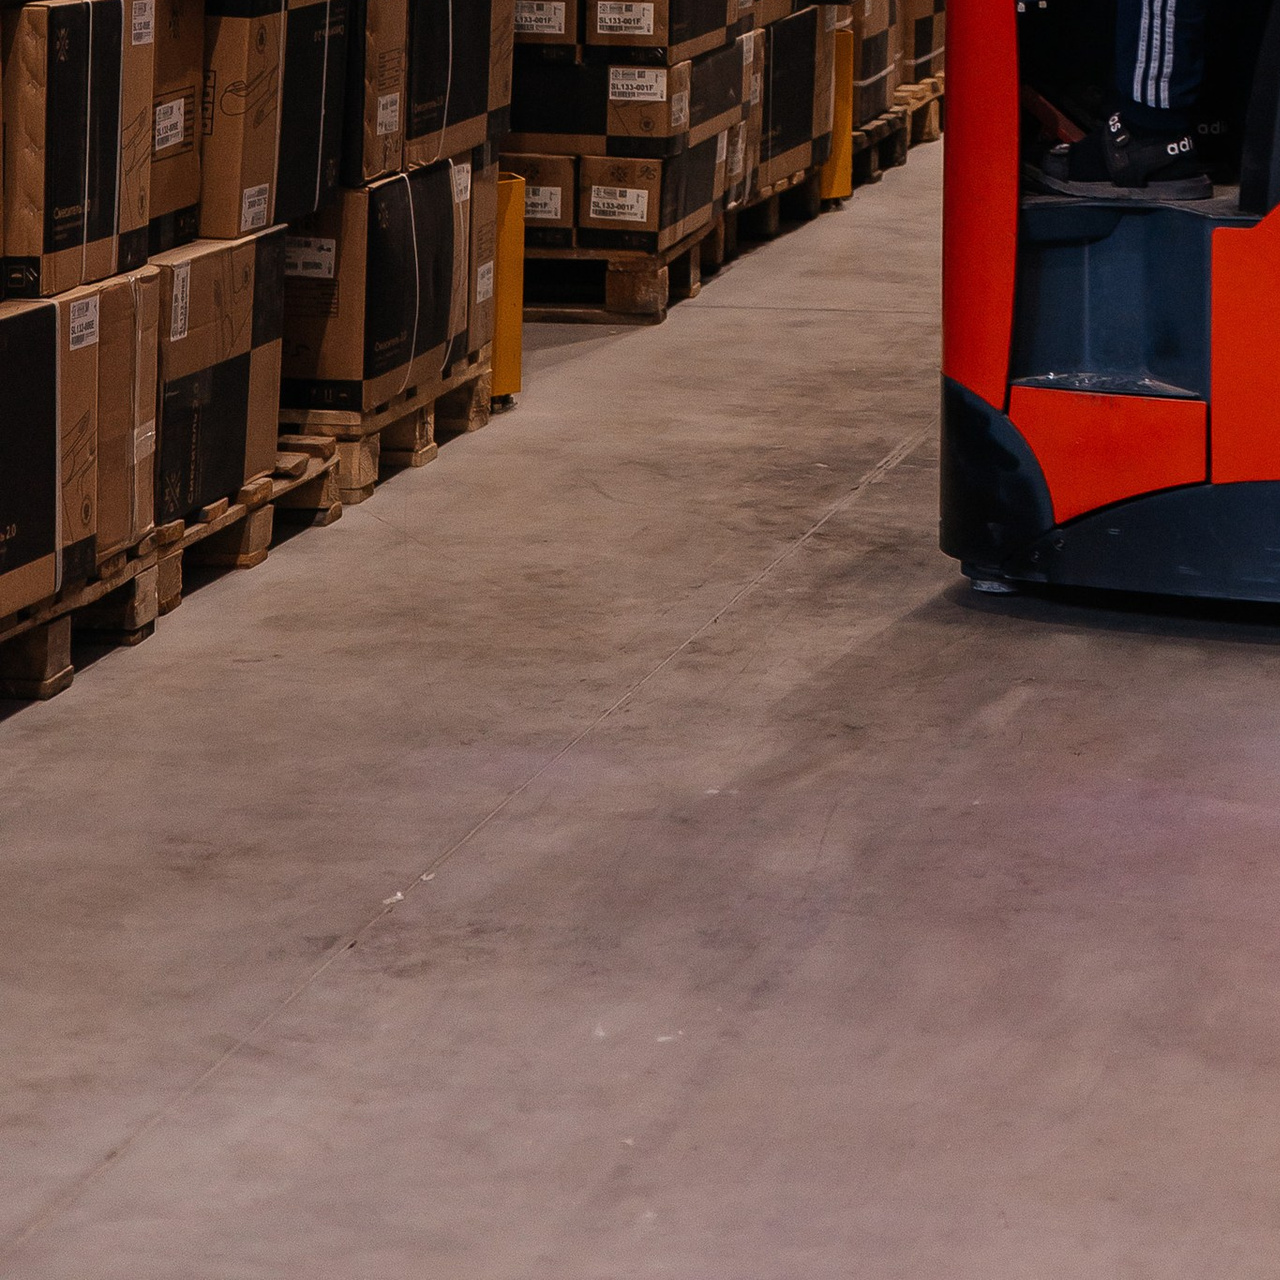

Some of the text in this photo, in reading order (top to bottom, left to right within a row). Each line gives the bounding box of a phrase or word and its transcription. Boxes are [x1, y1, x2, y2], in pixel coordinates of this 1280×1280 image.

[599, 17, 641, 25] SL133-001F
[611, 82, 653, 91] SL133-001F
[592, 201, 635, 211] SL133-001F
